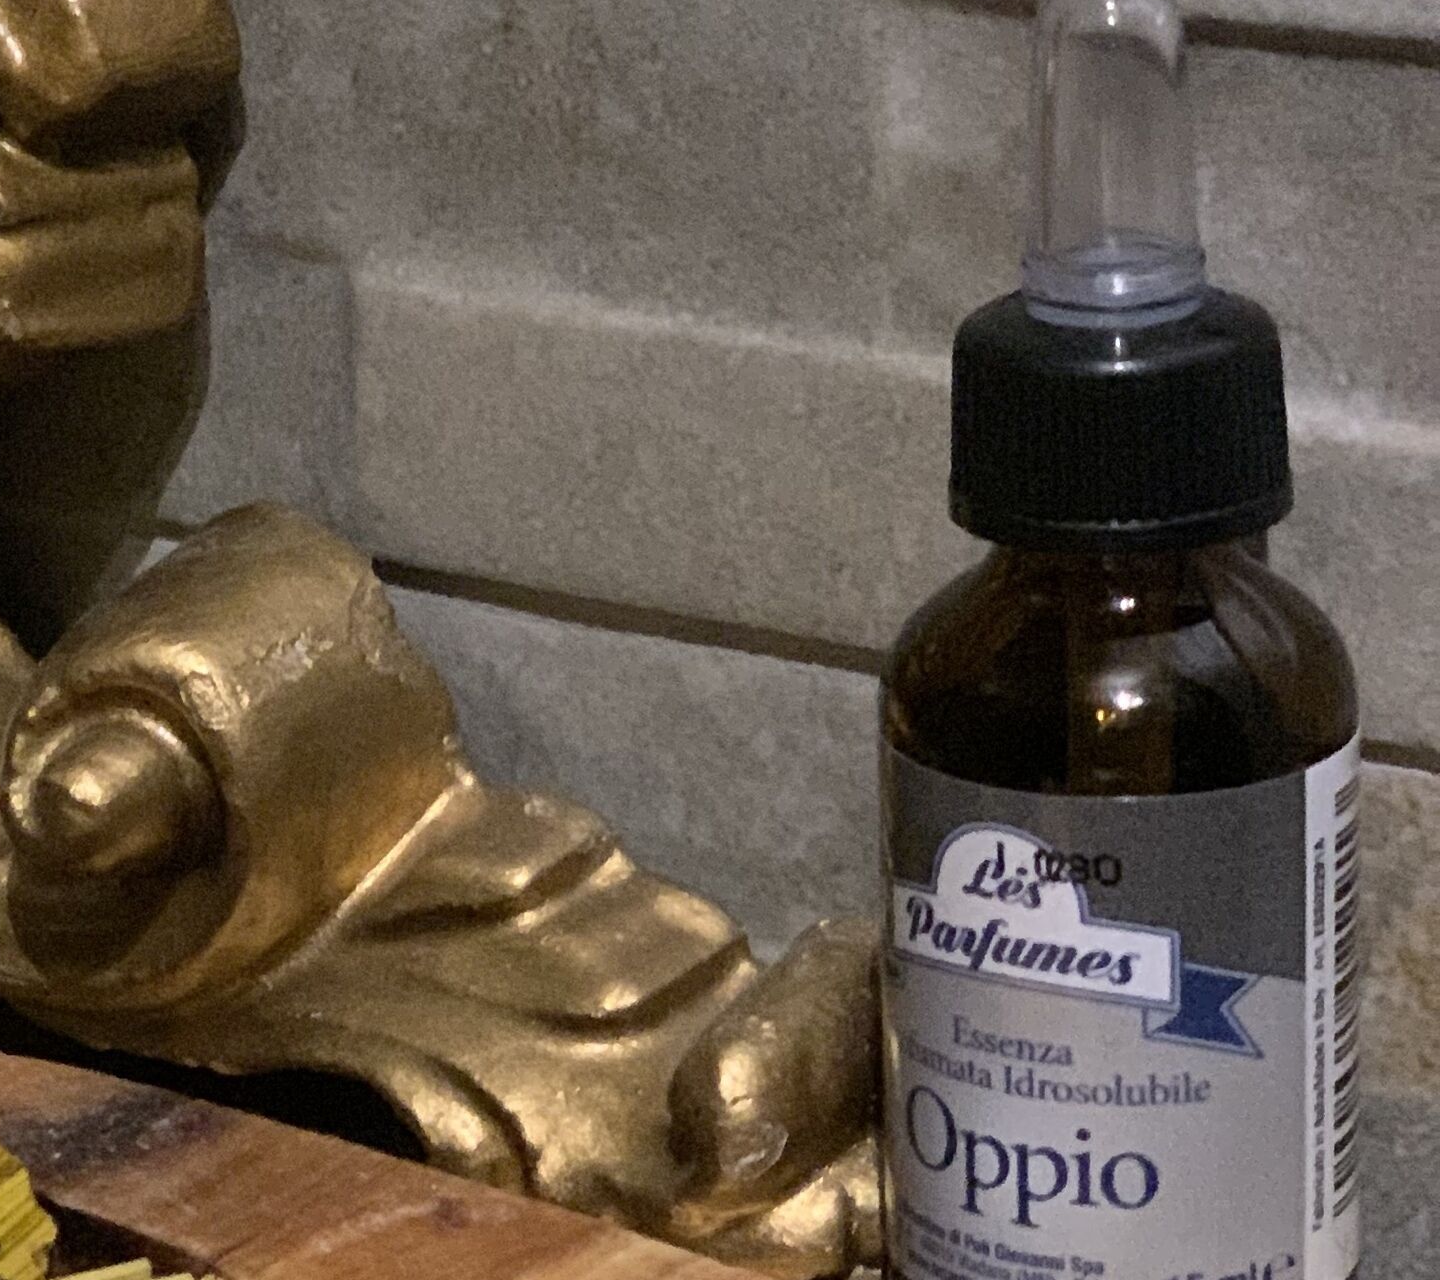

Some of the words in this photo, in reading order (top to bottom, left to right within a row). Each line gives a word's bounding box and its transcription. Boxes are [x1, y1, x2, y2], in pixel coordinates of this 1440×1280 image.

[907, 895, 1140, 985] Parfumes
[953, 1015, 1073, 1066] Essenza
[1005, 1065, 1212, 1107] Idrosolubile
[907, 1084, 1160, 1228] Oppio
